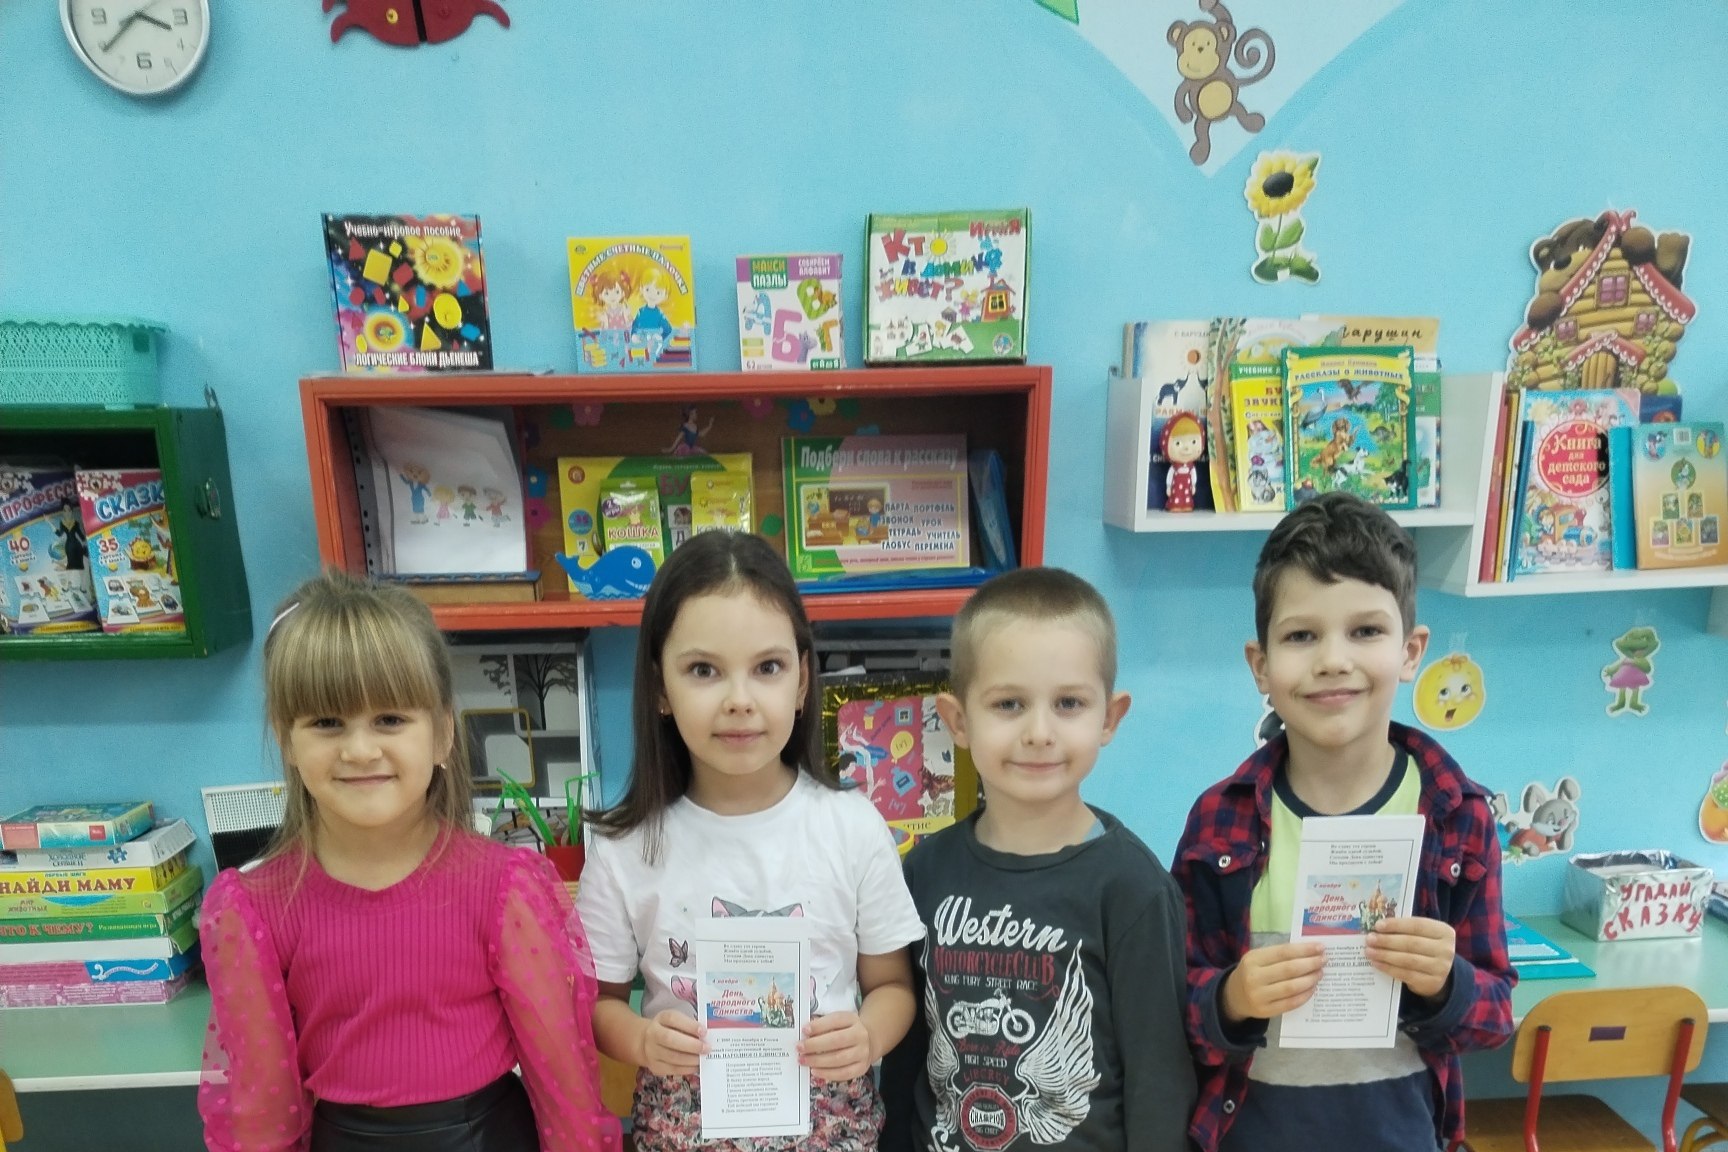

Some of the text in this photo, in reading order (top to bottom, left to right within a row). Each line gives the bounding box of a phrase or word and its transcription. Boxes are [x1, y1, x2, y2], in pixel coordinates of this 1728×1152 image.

[344, 221, 460, 240] Учебно-игровое пособие
[799, 267, 831, 275] АЛФАВИТ
[753, 274, 787, 288] ПАЗЛЫ
[356, 351, 479, 367] ЛОГИЧЕСКИЕ БЛОКИ ДЬЕНЕША
[1238, 366, 1273, 375] УЧЕБНИК
[1294, 369, 1340, 381] РАССКАЗЫ
[1353, 369, 1404, 380] ЖИВОТНЫХ
[1551, 434, 1602, 452] Книга
[801, 446, 854, 472] Подбери
[1568, 451, 1584, 461] для
[1548, 460, 1606, 474] детского
[1562, 473, 1590, 486] сада
[885, 503, 955, 512] ПАРТА ПОРТФЕЛЬ
[882, 515, 942, 527] ЗВОНОК УРОК
[608, 527, 659, 539] КОШКА
[889, 528, 961, 540] ТЕТРАДЬ УЧИТЕЛЬ
[8, 537, 30, 552] 40
[99, 538, 119, 552] 35
[882, 541, 955, 551] ГЛОБУС ПЕРЕМЕНА
[0, 877, 136, 894] НАЙДИ МАМУ
[1620, 876, 1691, 902] УГАДАЙ
[1321, 894, 1344, 903] День
[1309, 904, 1356, 914] народного
[934, 895, 1068, 953] Western
[1310, 914, 1353, 923] единства
[1603, 902, 1702, 940] СКАЗКУ
[29, 924, 41, 936] К
[42, 922, 94, 935] ЧЕМУ?
[944, 976, 960, 986] KING
[985, 977, 1012, 989] STREET
[1016, 980, 1038, 991] RACE
[722, 989, 744, 999] День
[711, 1000, 756, 1008] народного
[713, 1008, 754, 1017] единства
[983, 1056, 1008, 1068] SPEED
[970, 1108, 1005, 1129] CHAMPION
